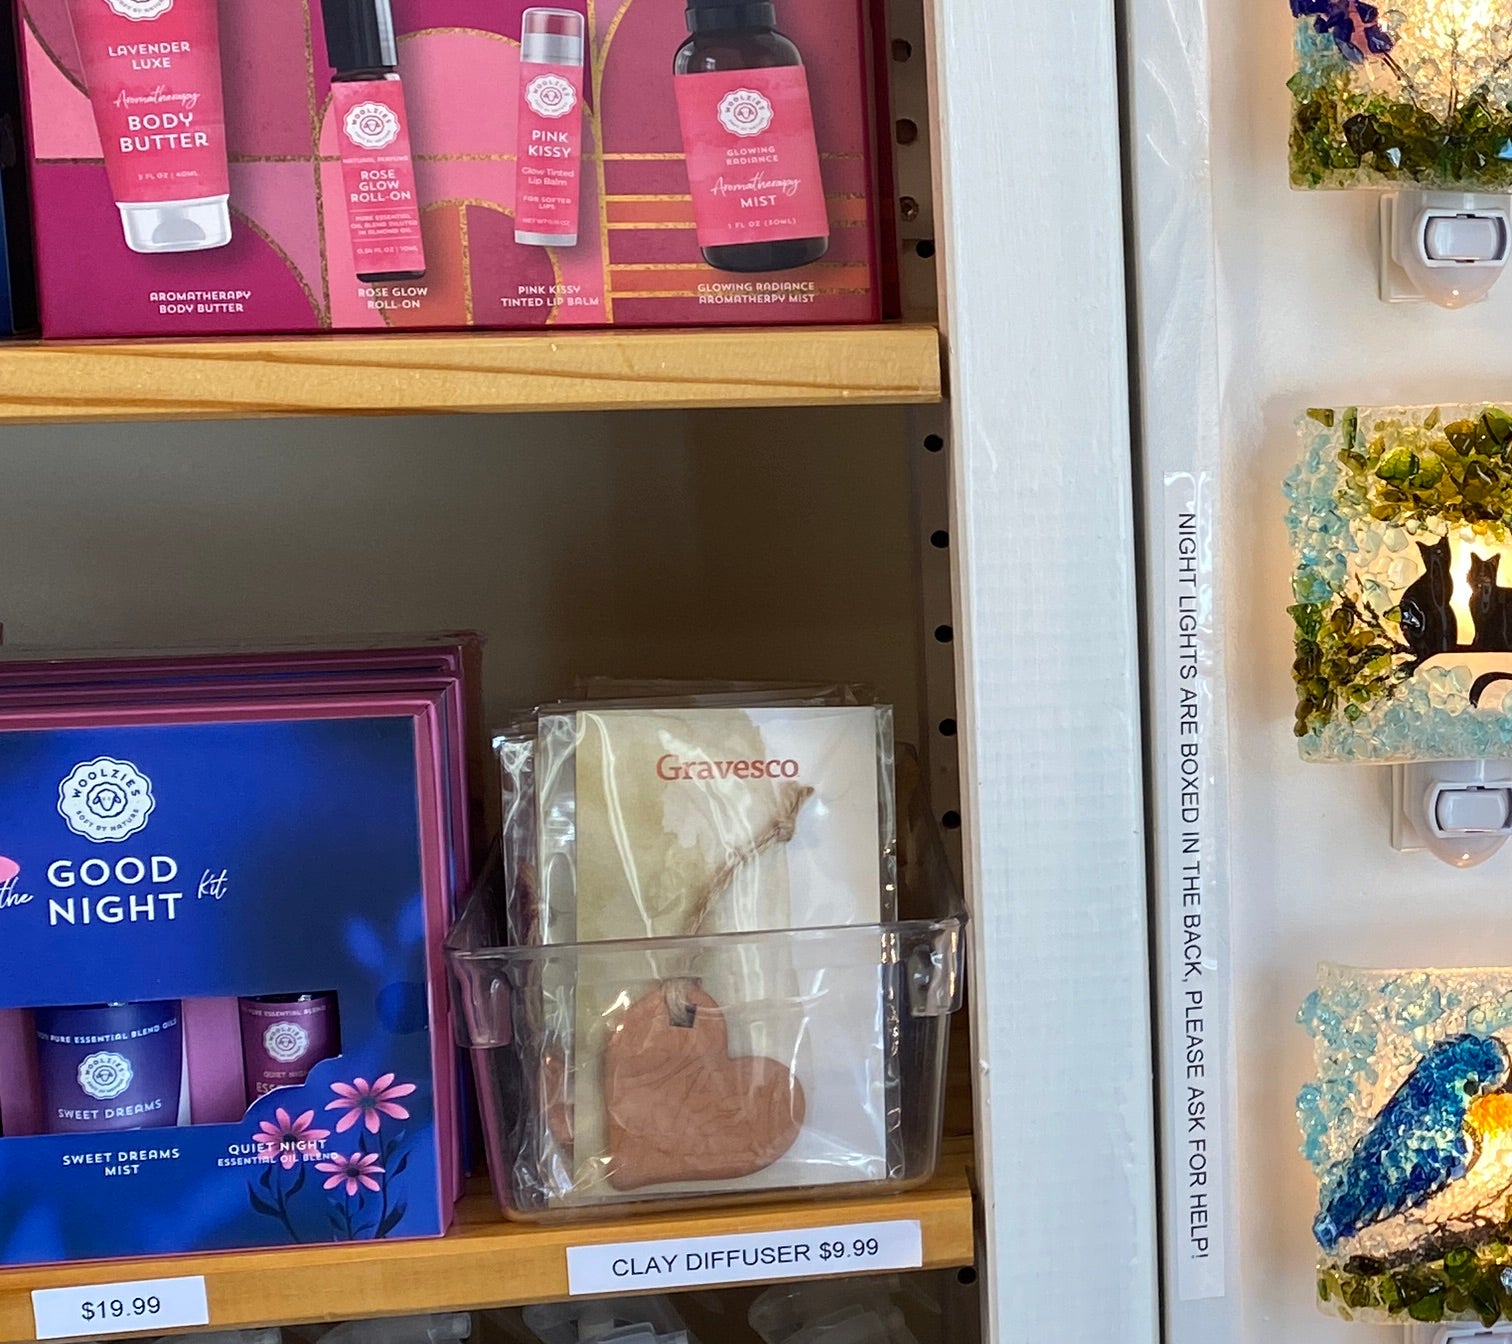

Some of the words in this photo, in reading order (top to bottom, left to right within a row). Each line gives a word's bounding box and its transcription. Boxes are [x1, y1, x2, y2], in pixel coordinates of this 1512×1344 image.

[108, 40, 191, 58] LAVENDER
[132, 56, 172, 71] LUXE
[112, 85, 200, 110] Aromatherapy
[127, 111, 195, 132] BODY
[119, 130, 209, 154] BUTTER
[531, 129, 569, 144] PINK
[528, 144, 572, 159] KISSY
[726, 146, 776, 157] GLOWING
[726, 155, 779, 166] RADIANCE
[360, 169, 396, 181] ROSE
[710, 171, 801, 197] Aromatherapy
[358, 180, 400, 192] GLOW
[350, 191, 411, 203] ROLL-ON
[740, 195, 776, 209] MIST
[149, 290, 252, 303] AROMATHERAPY
[357, 287, 389, 298] ROSE
[391, 286, 428, 297] GLOW
[518, 285, 545, 295] PINK
[548, 284, 581, 295] KISSY
[697, 283, 752, 292] GLOWING
[756, 282, 815, 292] RADIANCE
[159, 303, 196, 315] BODY
[197, 302, 244, 314] BUTTER
[367, 299, 421, 310] ROLL-ON
[500, 297, 544, 308] TINTED
[547, 296, 564, 307] LIP
[567, 296, 599, 306] BALM
[698, 294, 785, 305] AROMATHERPY
[788, 293, 815, 303] MIST
[1178, 512, 1197, 587] NIGHT
[1178, 594, 1198, 679] LIGHTS
[1180, 687, 1198, 735] ARE
[656, 753, 800, 781] Gravesco
[72, 769, 141, 798] WOOLZIES
[1180, 743, 1199, 824] BOXED
[75, 809, 94, 828] SOFT
[110, 808, 140, 831] NATURE
[1182, 832, 1199, 854] IN
[47, 855, 178, 888] GOOD
[0, 877, 34, 907] the
[197, 869, 229, 900] Kit
[1182, 862, 1200, 907] THE
[49, 893, 183, 926] NIGHT
[1182, 914, 1203, 983] BACK,
[74, 1032, 128, 1044] ESSENTIAL
[130, 1025, 160, 1039] BLEND
[162, 1018, 178, 1030] OILS
[1185, 990, 1205, 1080] PLEASE
[58, 1108, 98, 1120] SWEET
[105, 1099, 162, 1119] DREAMS
[1187, 1087, 1206, 1131] ASK
[228, 1141, 275, 1154] QUIET
[280, 1138, 327, 1152] NIGHT
[62, 1152, 112, 1166] SWEET
[118, 1148, 180, 1163] DREAMS
[217, 1155, 277, 1167] ESSENTIAL
[280, 1153, 299, 1164] OIL
[302, 1151, 339, 1163] BLEND
[1188, 1138, 1206, 1188] FOR
[105, 1164, 140, 1177] MIST
[1189, 1194, 1209, 1259] HELP!
[611, 1254, 678, 1278] CLAY
[686, 1244, 811, 1272] DIFFUSER
[819, 1237, 879, 1262] $9.99
[80, 1295, 161, 1322] $19.99
